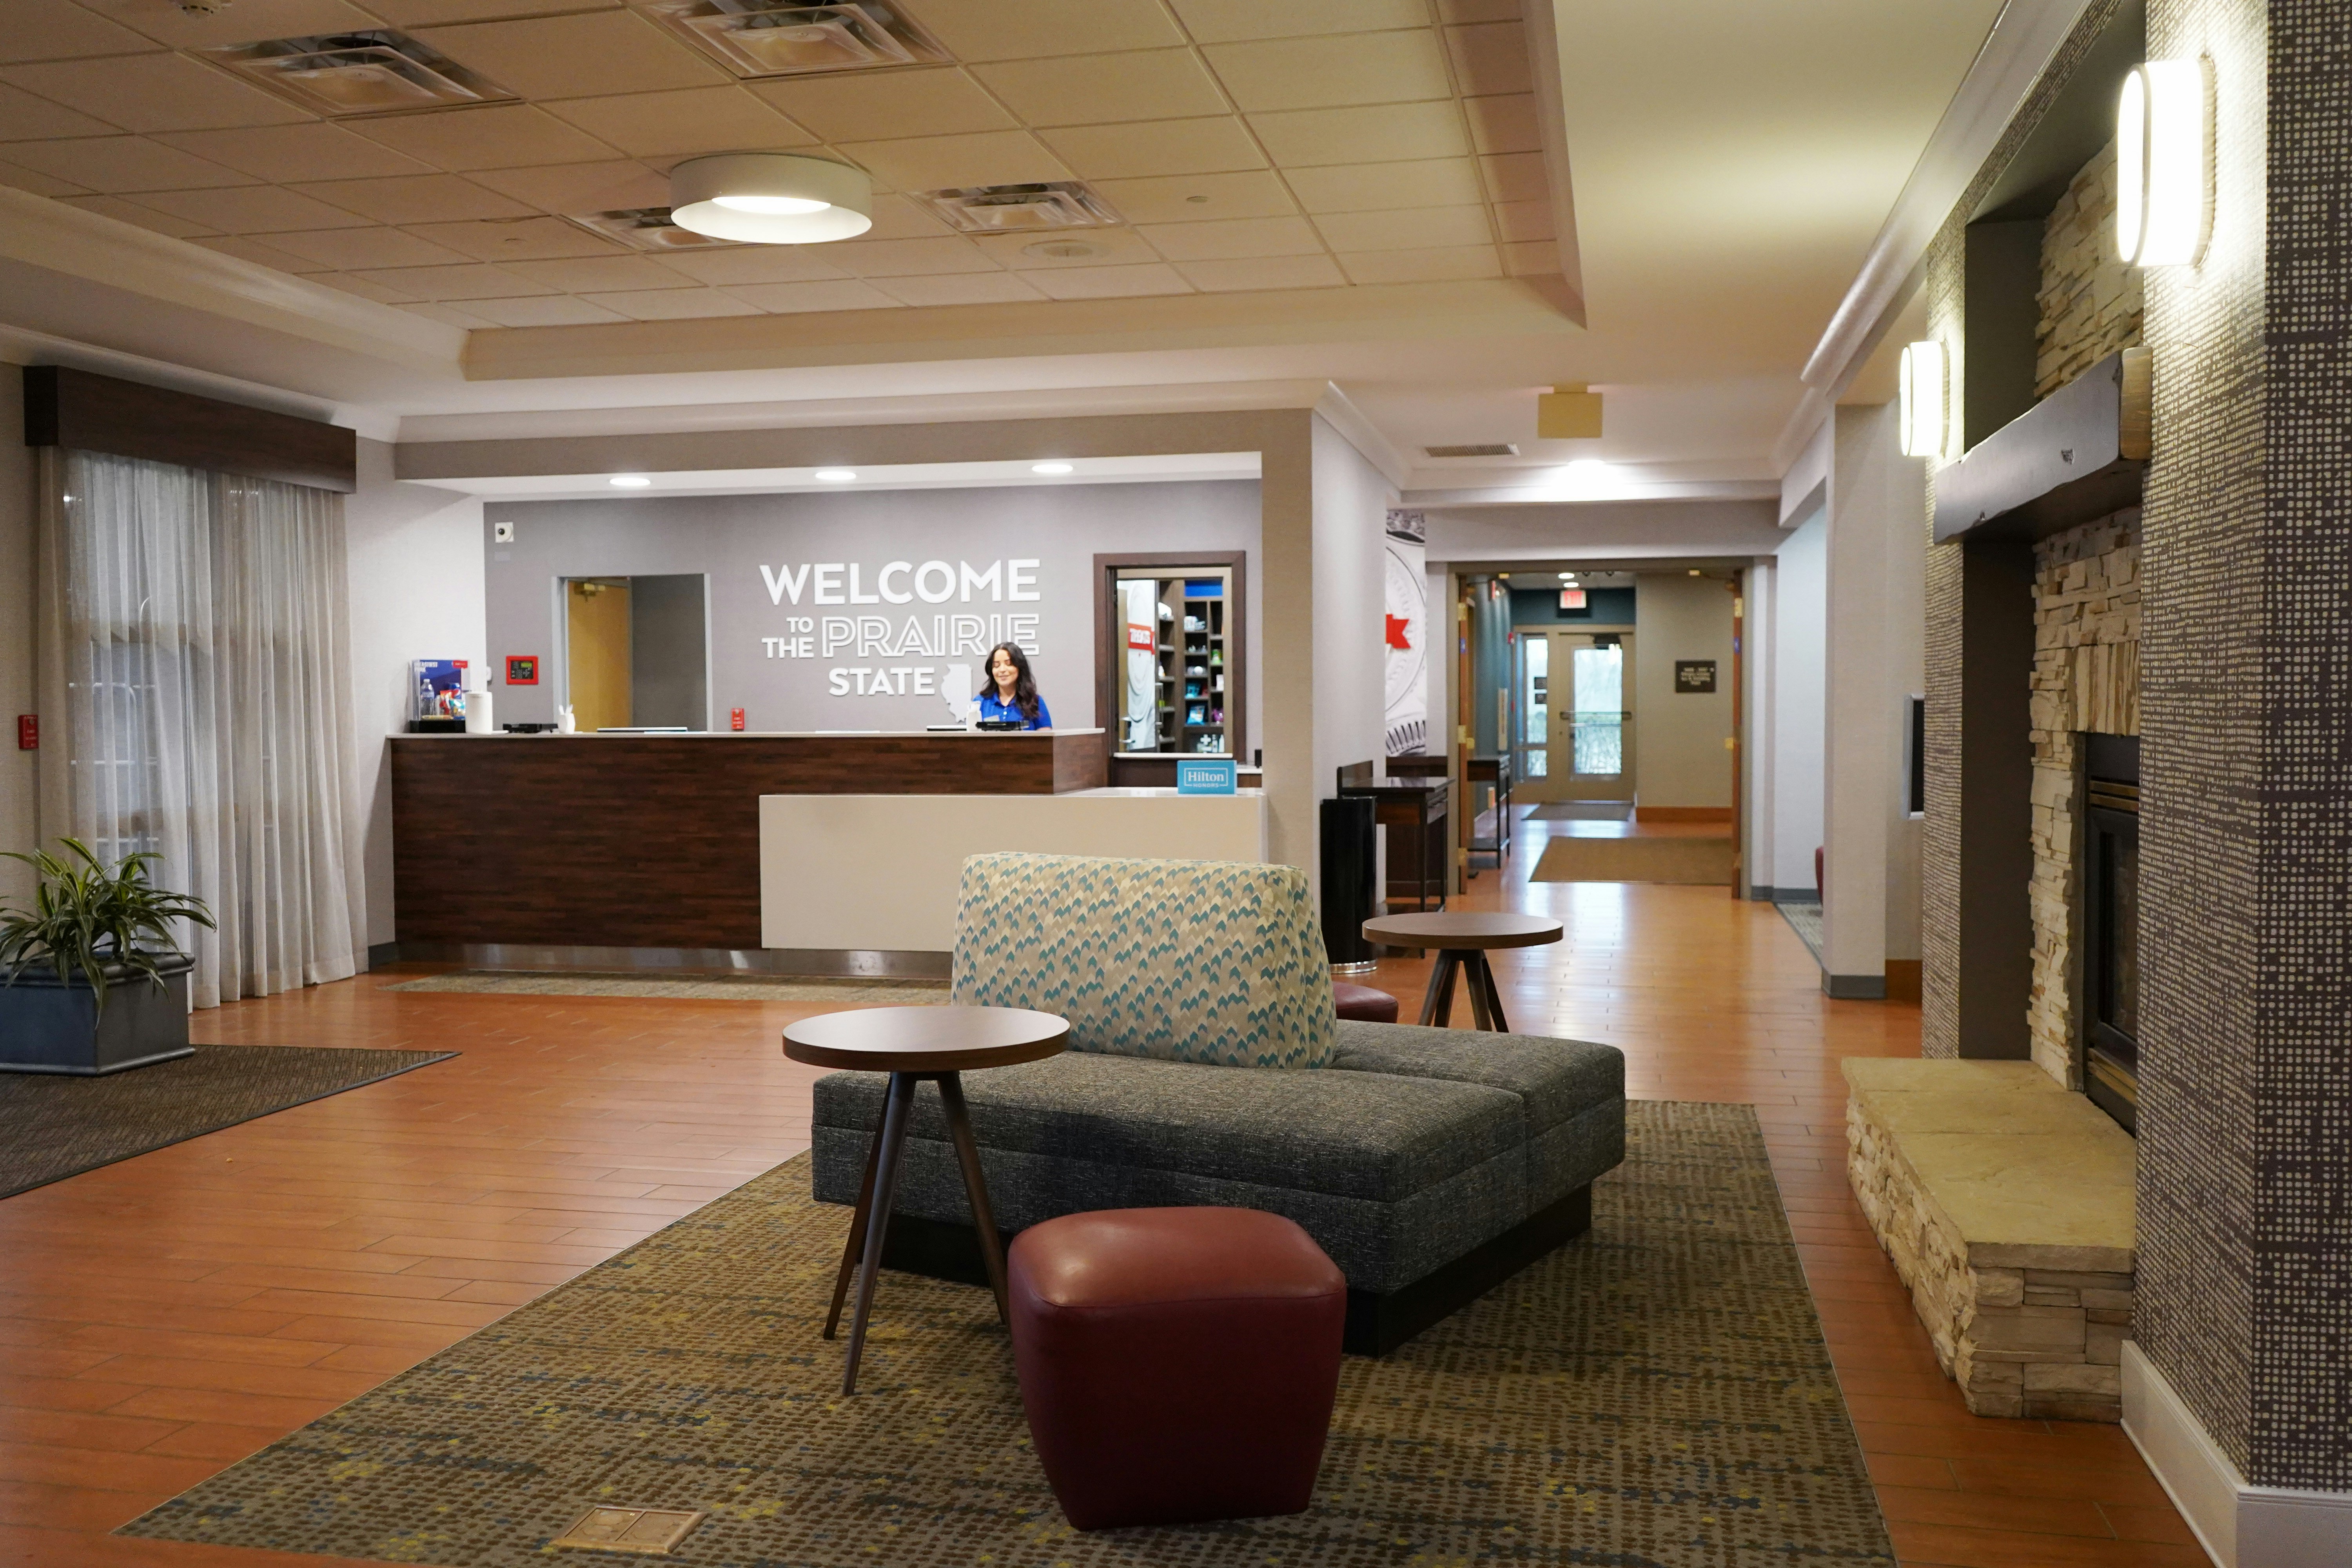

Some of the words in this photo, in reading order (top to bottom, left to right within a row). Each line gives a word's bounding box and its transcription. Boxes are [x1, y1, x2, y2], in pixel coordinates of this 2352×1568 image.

[759, 559, 1041, 606] WELCOME
[787, 617, 813, 633] TO
[822, 613, 1040, 658] PRAIRIE
[761, 637, 815, 659] THE
[828, 666, 935, 696] STATE
[1188, 771, 1224, 782] Hilton
